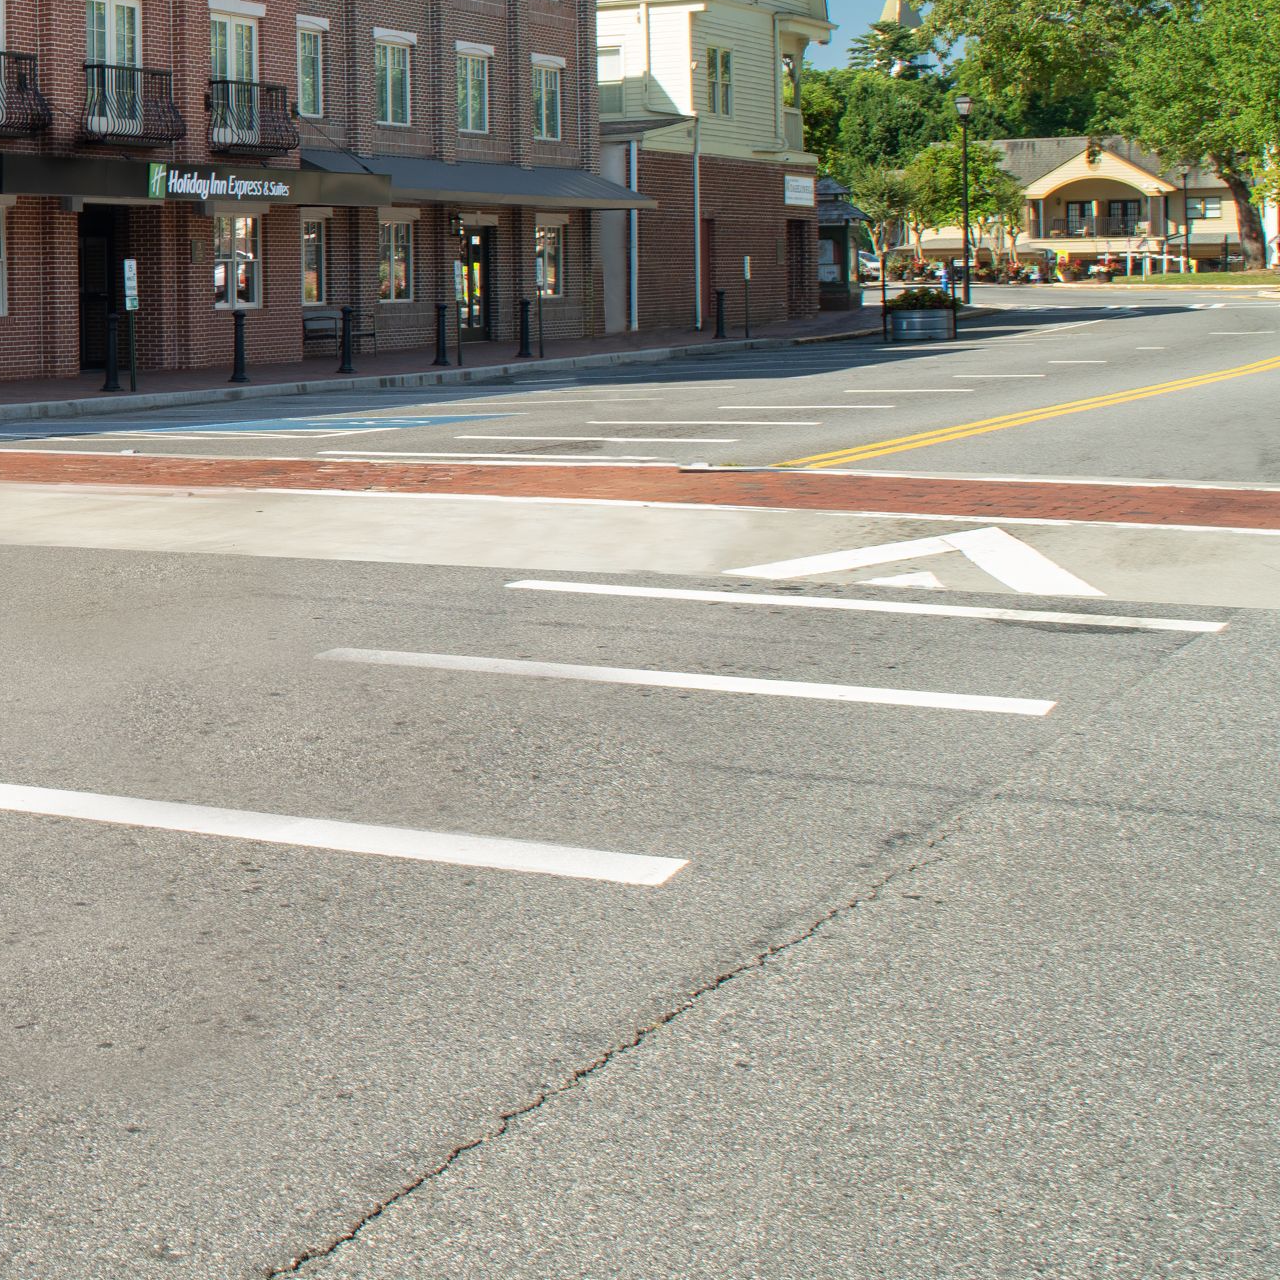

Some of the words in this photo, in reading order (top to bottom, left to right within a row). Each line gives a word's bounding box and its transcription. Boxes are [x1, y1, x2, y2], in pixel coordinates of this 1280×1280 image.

[167, 170, 210, 200] Holiday
[210, 172, 227, 194] Inn
[227, 175, 262, 200] Express
[263, 181, 269, 195] &
[269, 182, 290, 196] Suites
